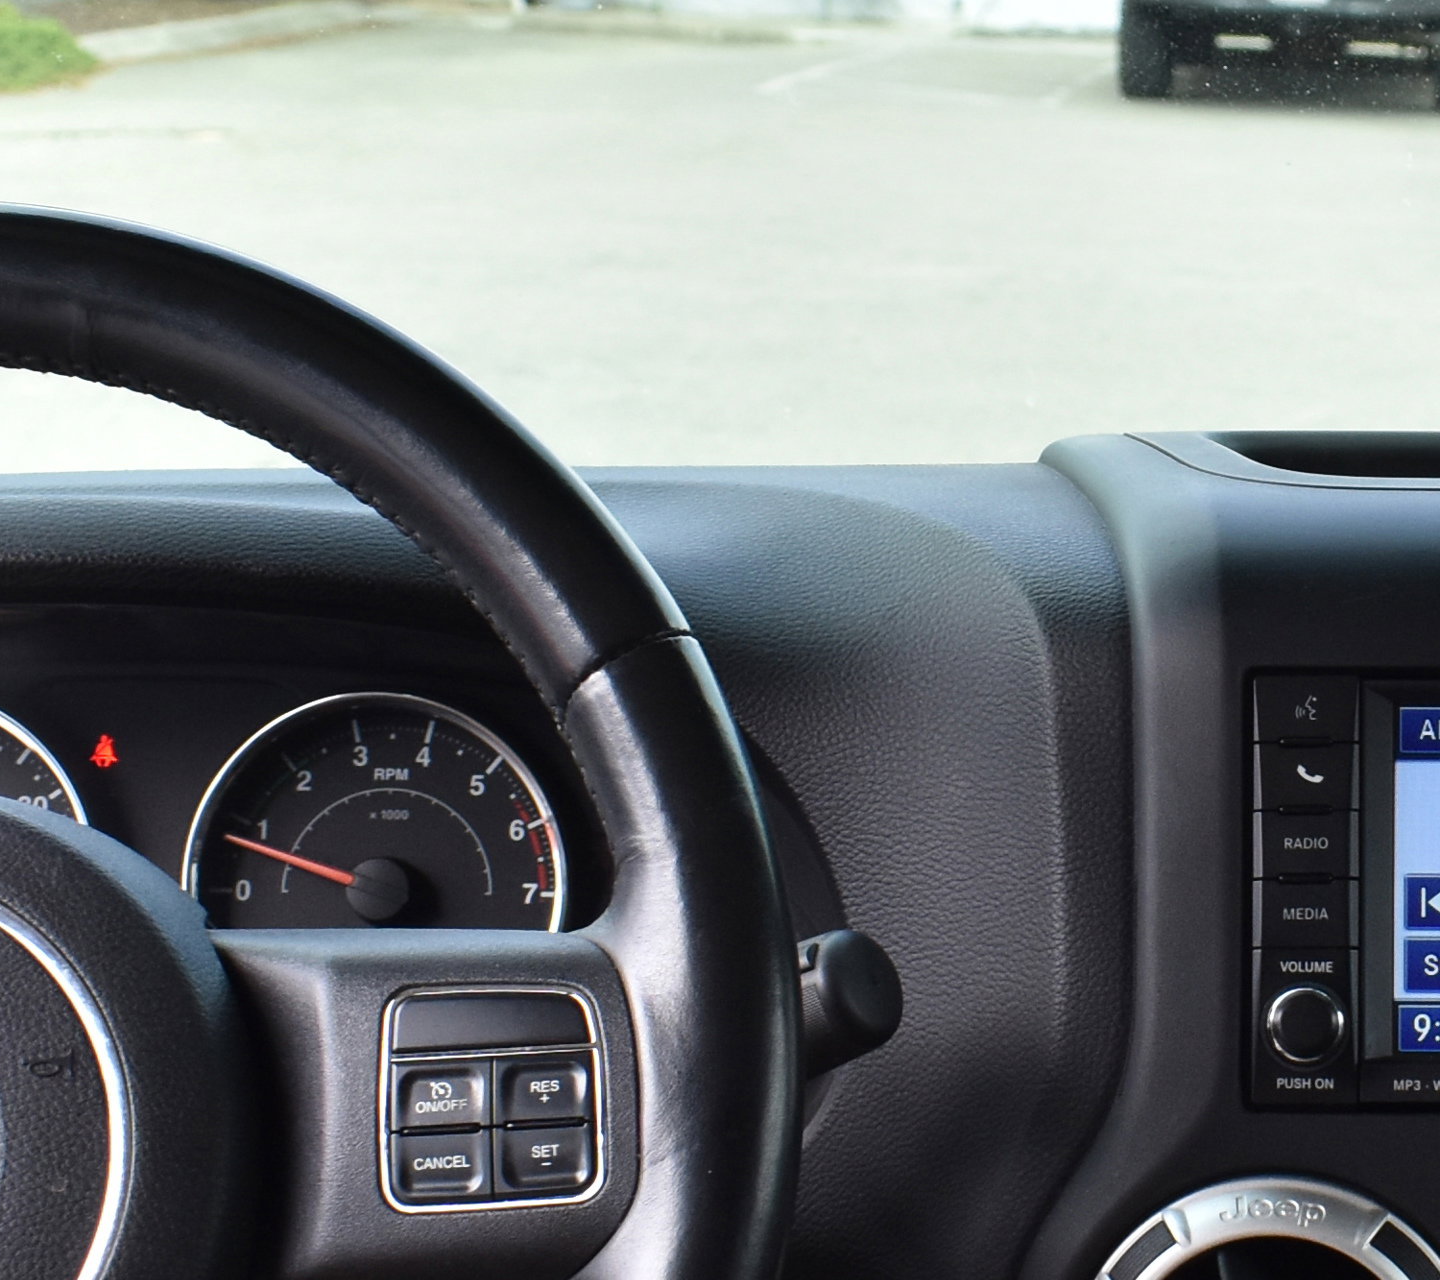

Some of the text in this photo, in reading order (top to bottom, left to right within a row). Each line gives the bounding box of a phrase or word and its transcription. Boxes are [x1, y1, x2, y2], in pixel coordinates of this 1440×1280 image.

[352, 745, 369, 768] 3
[414, 747, 432, 768] 4
[295, 770, 312, 791] 2
[373, 767, 409, 782] RPM
[469, 775, 485, 796] 5
[259, 820, 269, 838] 1
[508, 819, 525, 842] 6
[1283, 837, 1329, 851] RADIO
[234, 880, 252, 902] 0
[522, 883, 539, 905] 7
[1282, 907, 1329, 920] MEDIA
[1280, 961, 1334, 973] VOLUME
[529, 1079, 560, 1094] RES
[1276, 1077, 1334, 1089] PUSH ON
[1393, 1080, 1422, 1092] MP3
[415, 1098, 468, 1114] ON/OFF
[530, 1144, 560, 1159] SET
[413, 1154, 471, 1171] CANCEL
[1218, 1193, 1327, 1228] Jeep
